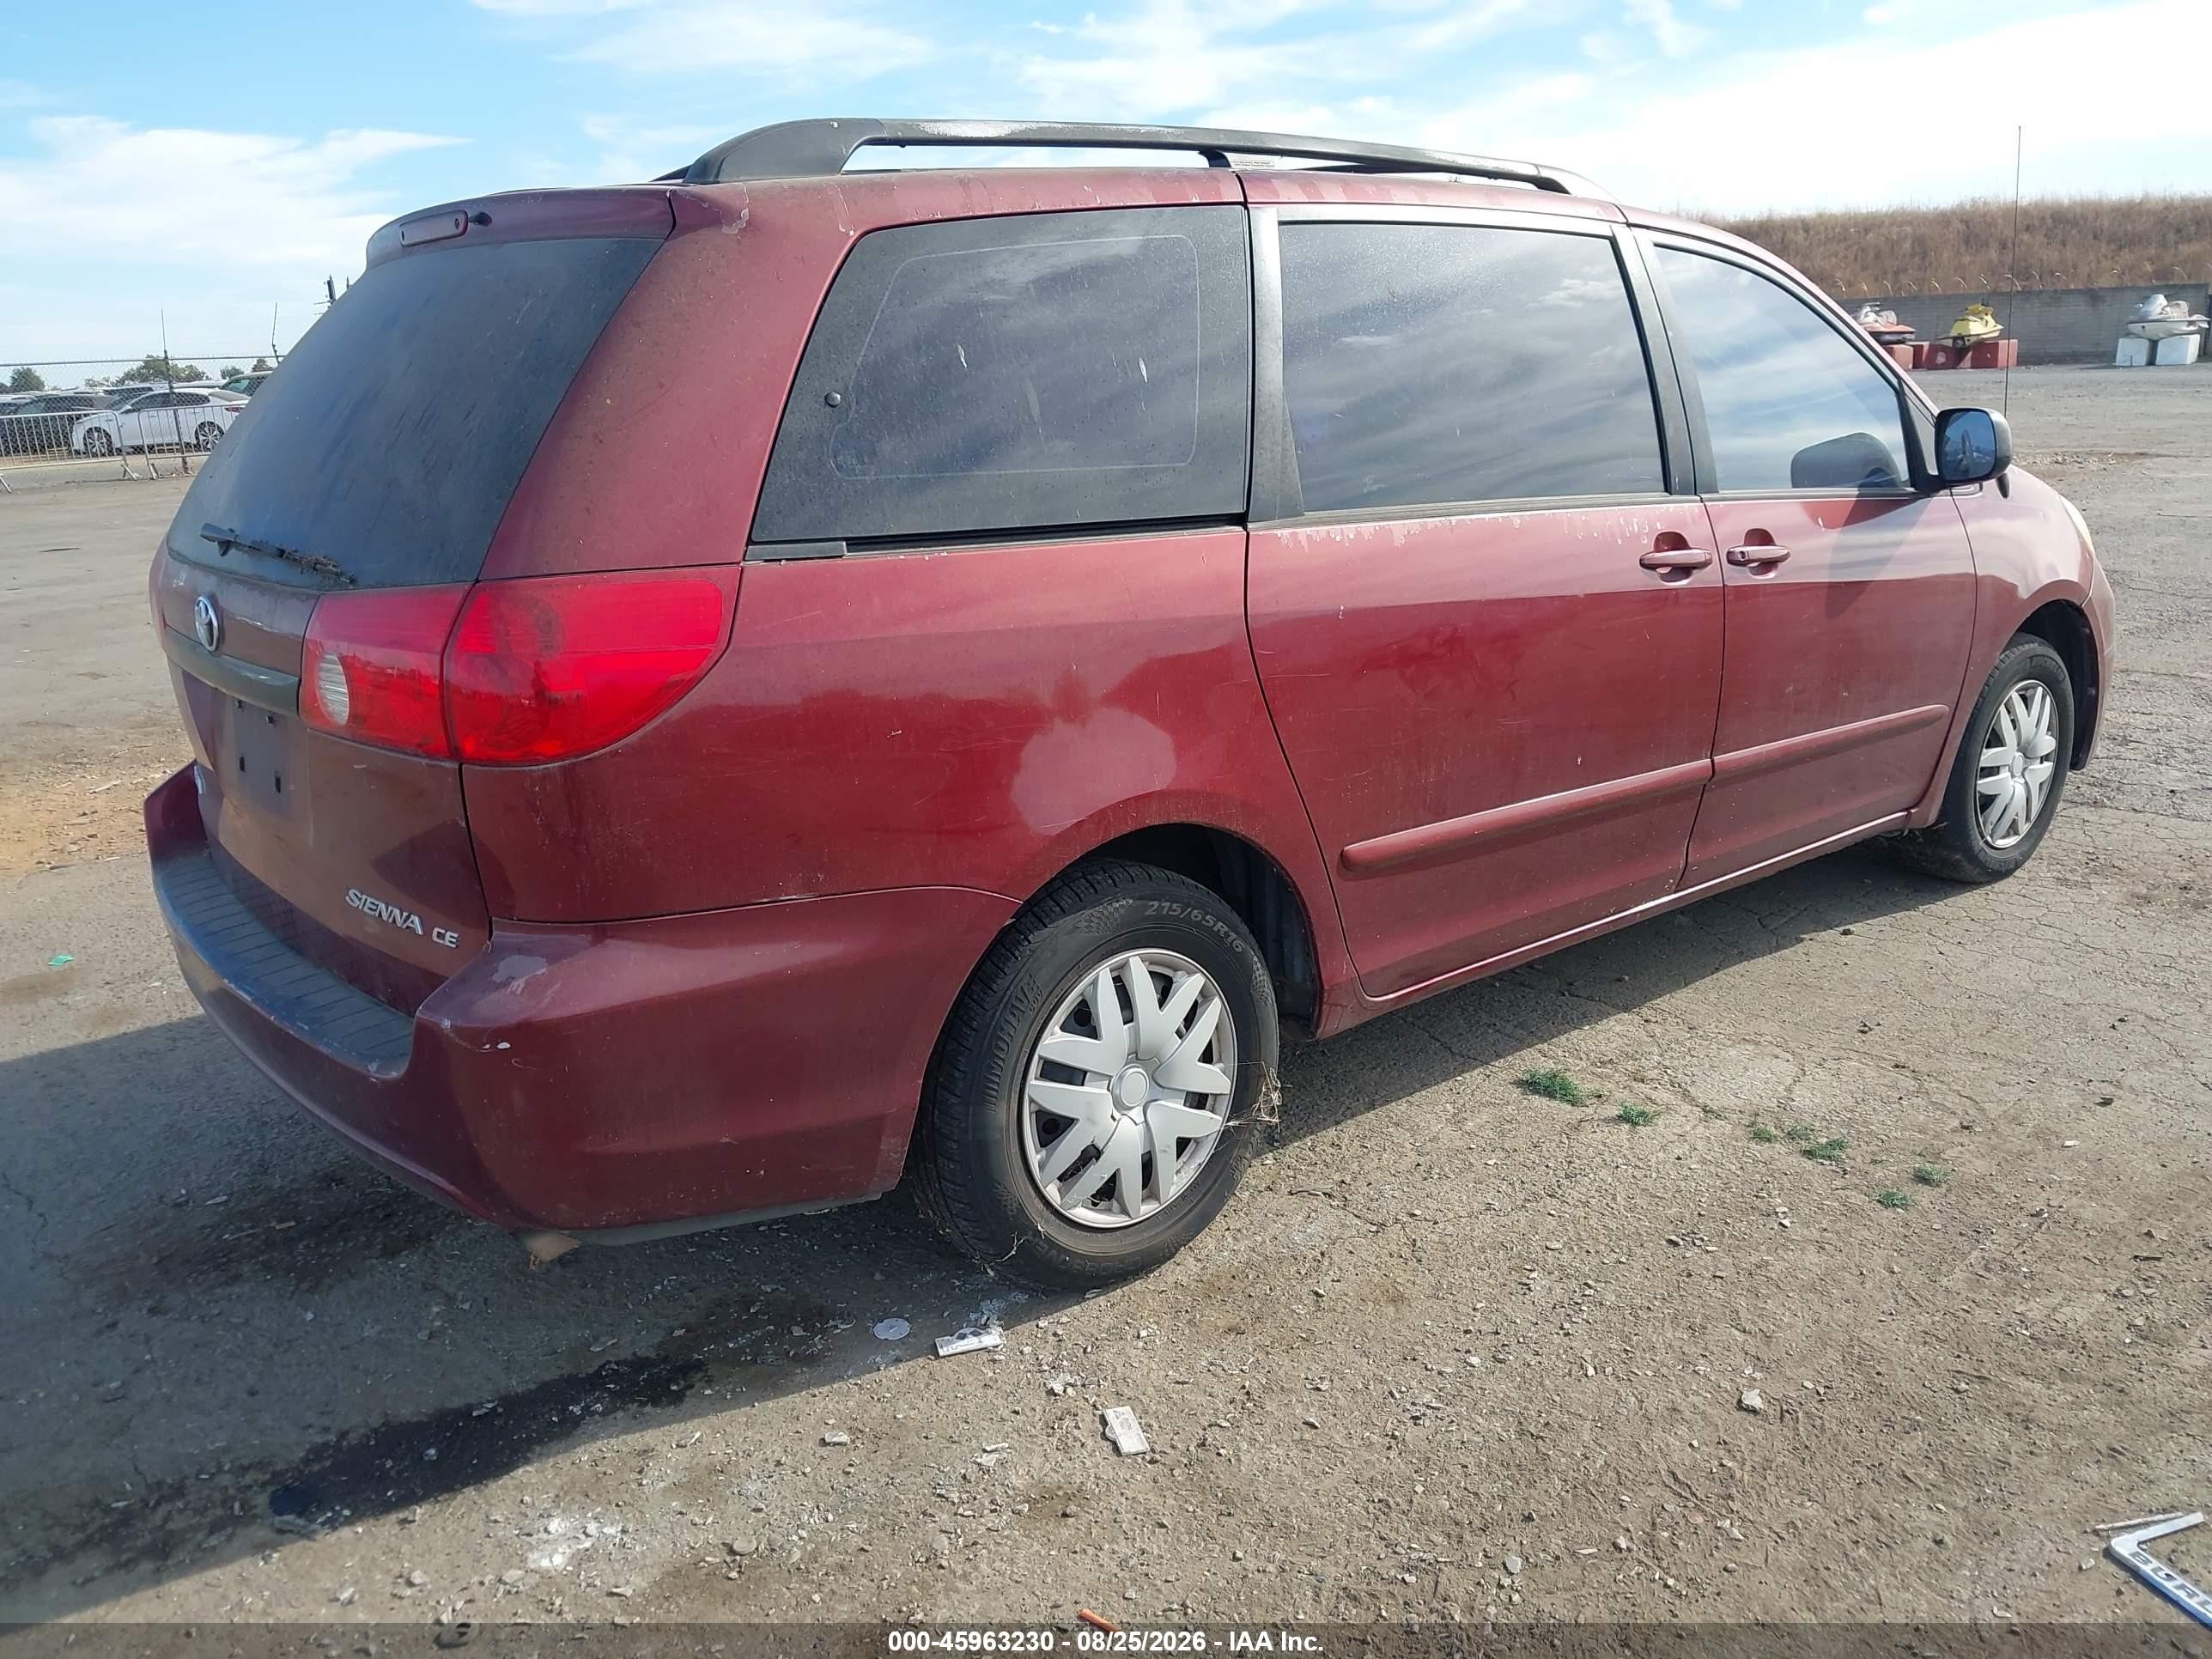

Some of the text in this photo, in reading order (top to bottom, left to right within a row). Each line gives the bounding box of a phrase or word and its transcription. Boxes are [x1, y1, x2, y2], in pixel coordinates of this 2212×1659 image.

[345, 889, 459, 948] SIENNA CE
[1145, 901, 1245, 952] 215/65R16
